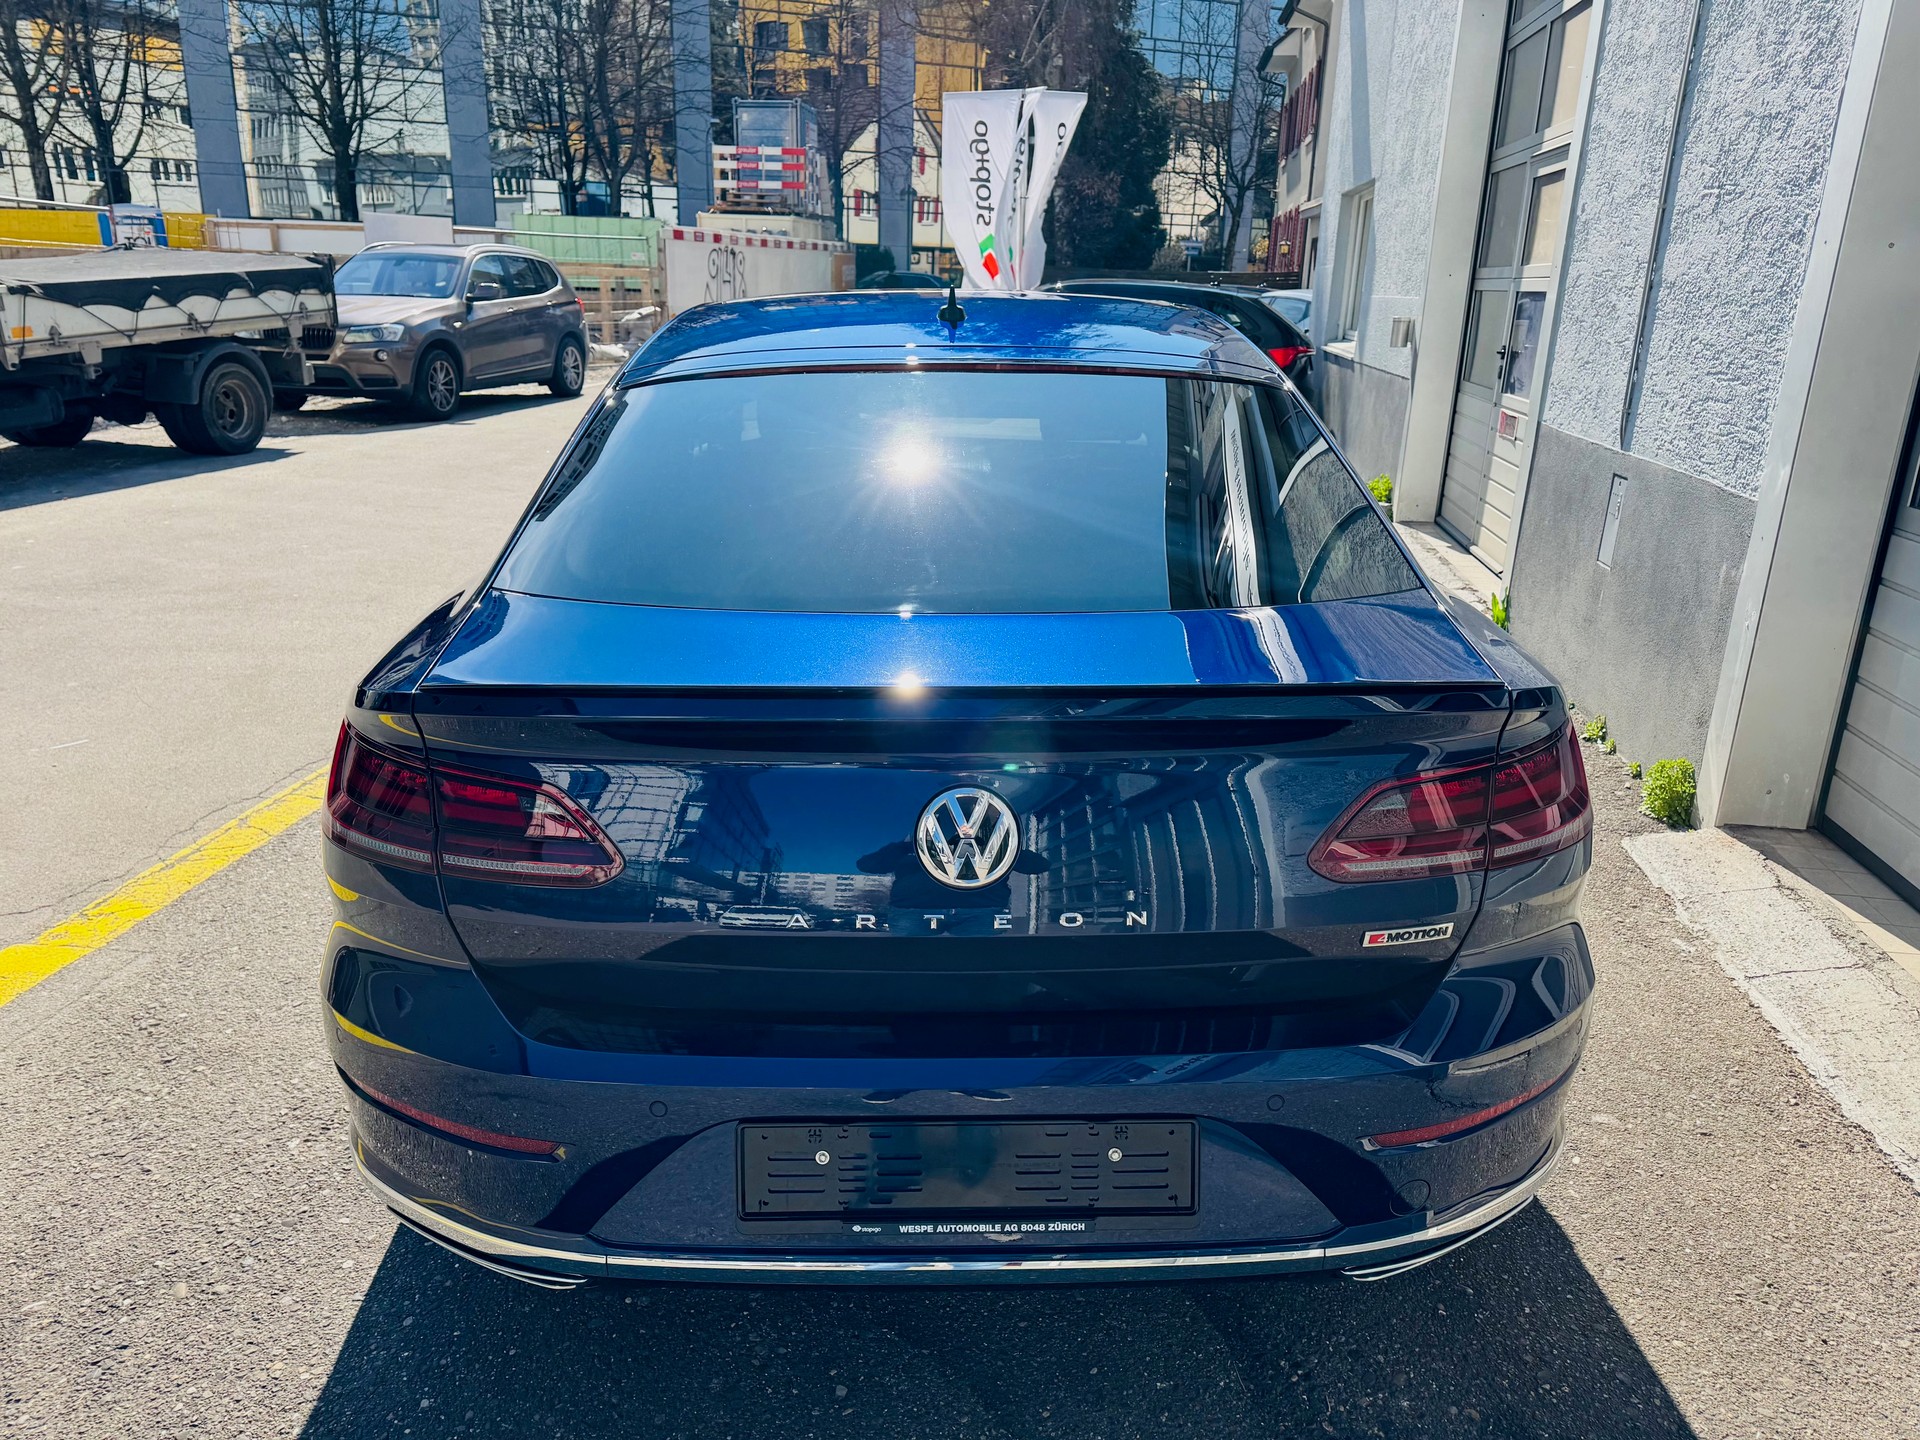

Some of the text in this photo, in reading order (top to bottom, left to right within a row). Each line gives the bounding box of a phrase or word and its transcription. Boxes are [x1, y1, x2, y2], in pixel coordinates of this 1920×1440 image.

[916, 787, 1019, 887] VW
[785, 910, 1148, 930] ARTEON
[1375, 926, 1450, 943] 4MOTION
[899, 1221, 1085, 1233] WESPE AUTOMOBILE AG 8048 ZÜRICH
